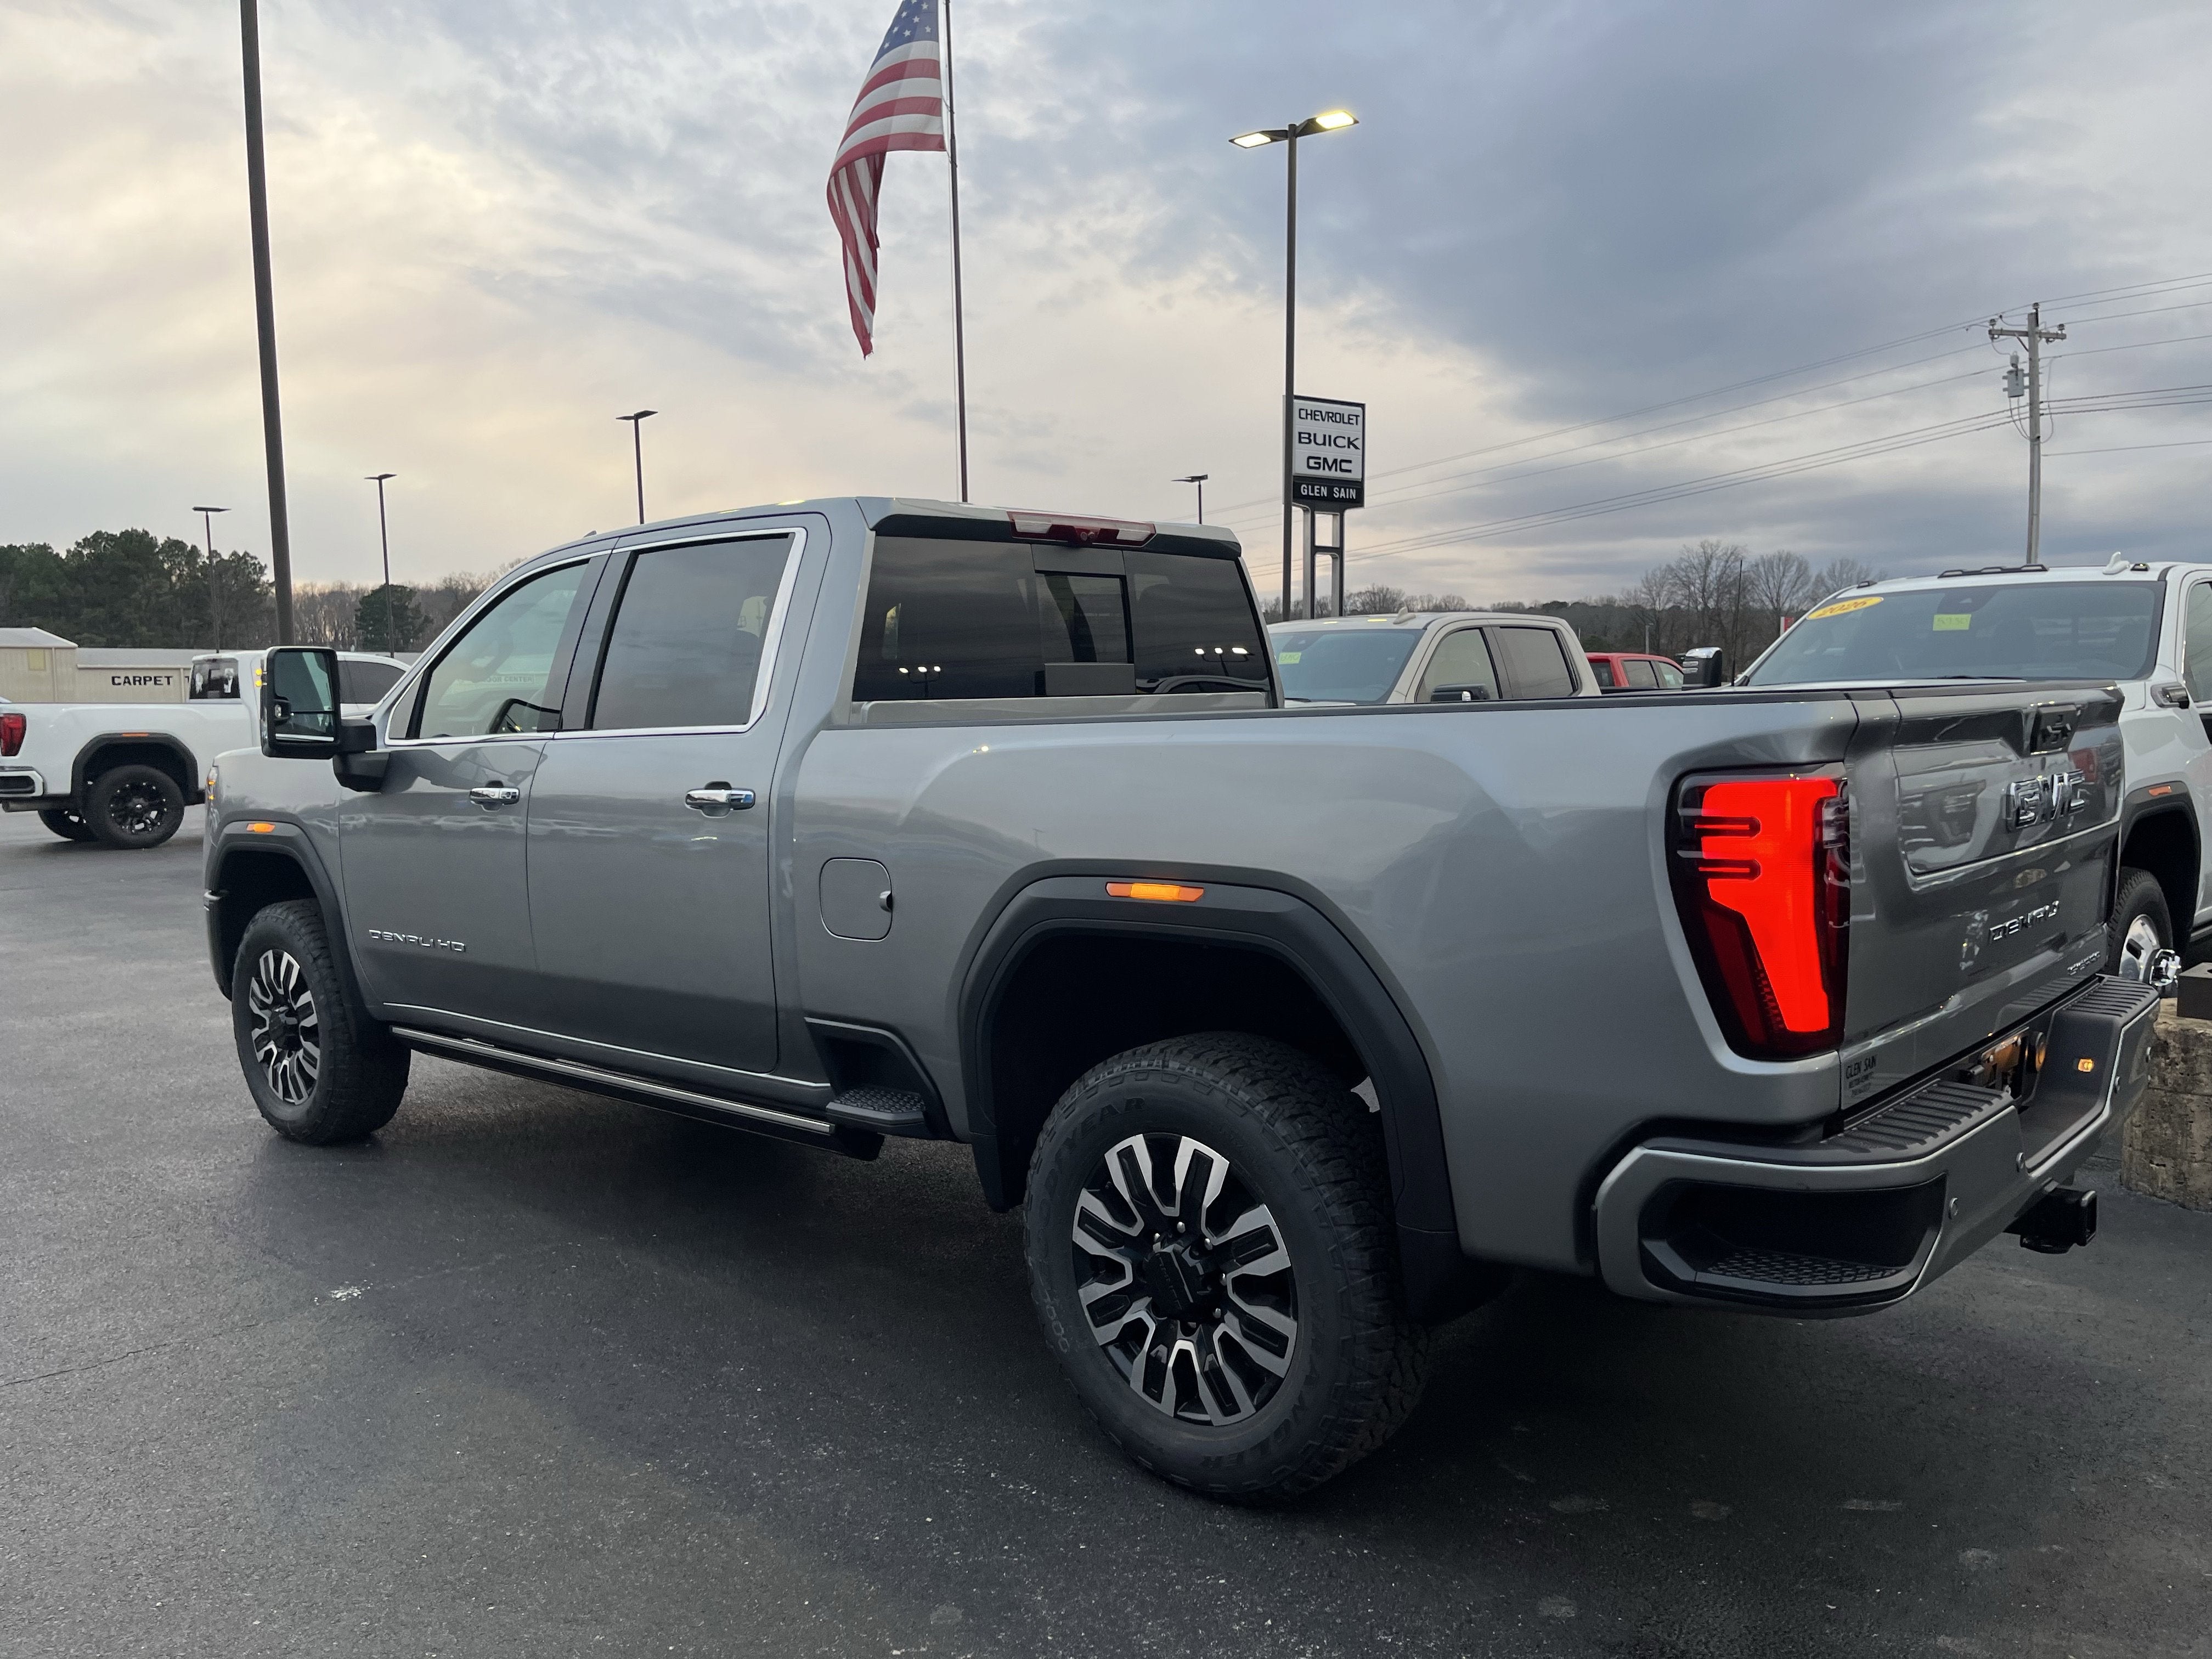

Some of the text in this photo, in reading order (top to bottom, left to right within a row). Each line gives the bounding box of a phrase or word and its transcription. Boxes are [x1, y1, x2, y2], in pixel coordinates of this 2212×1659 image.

[1299, 408, 1360, 425] CHEVROLET
[1298, 432, 1360, 450] BUICK
[1307, 456, 1352, 473] GMC
[1300, 484, 1356, 499] GLEN SAIN
[111, 676, 173, 686] CARPET
[369, 929, 435, 948] DENALI
